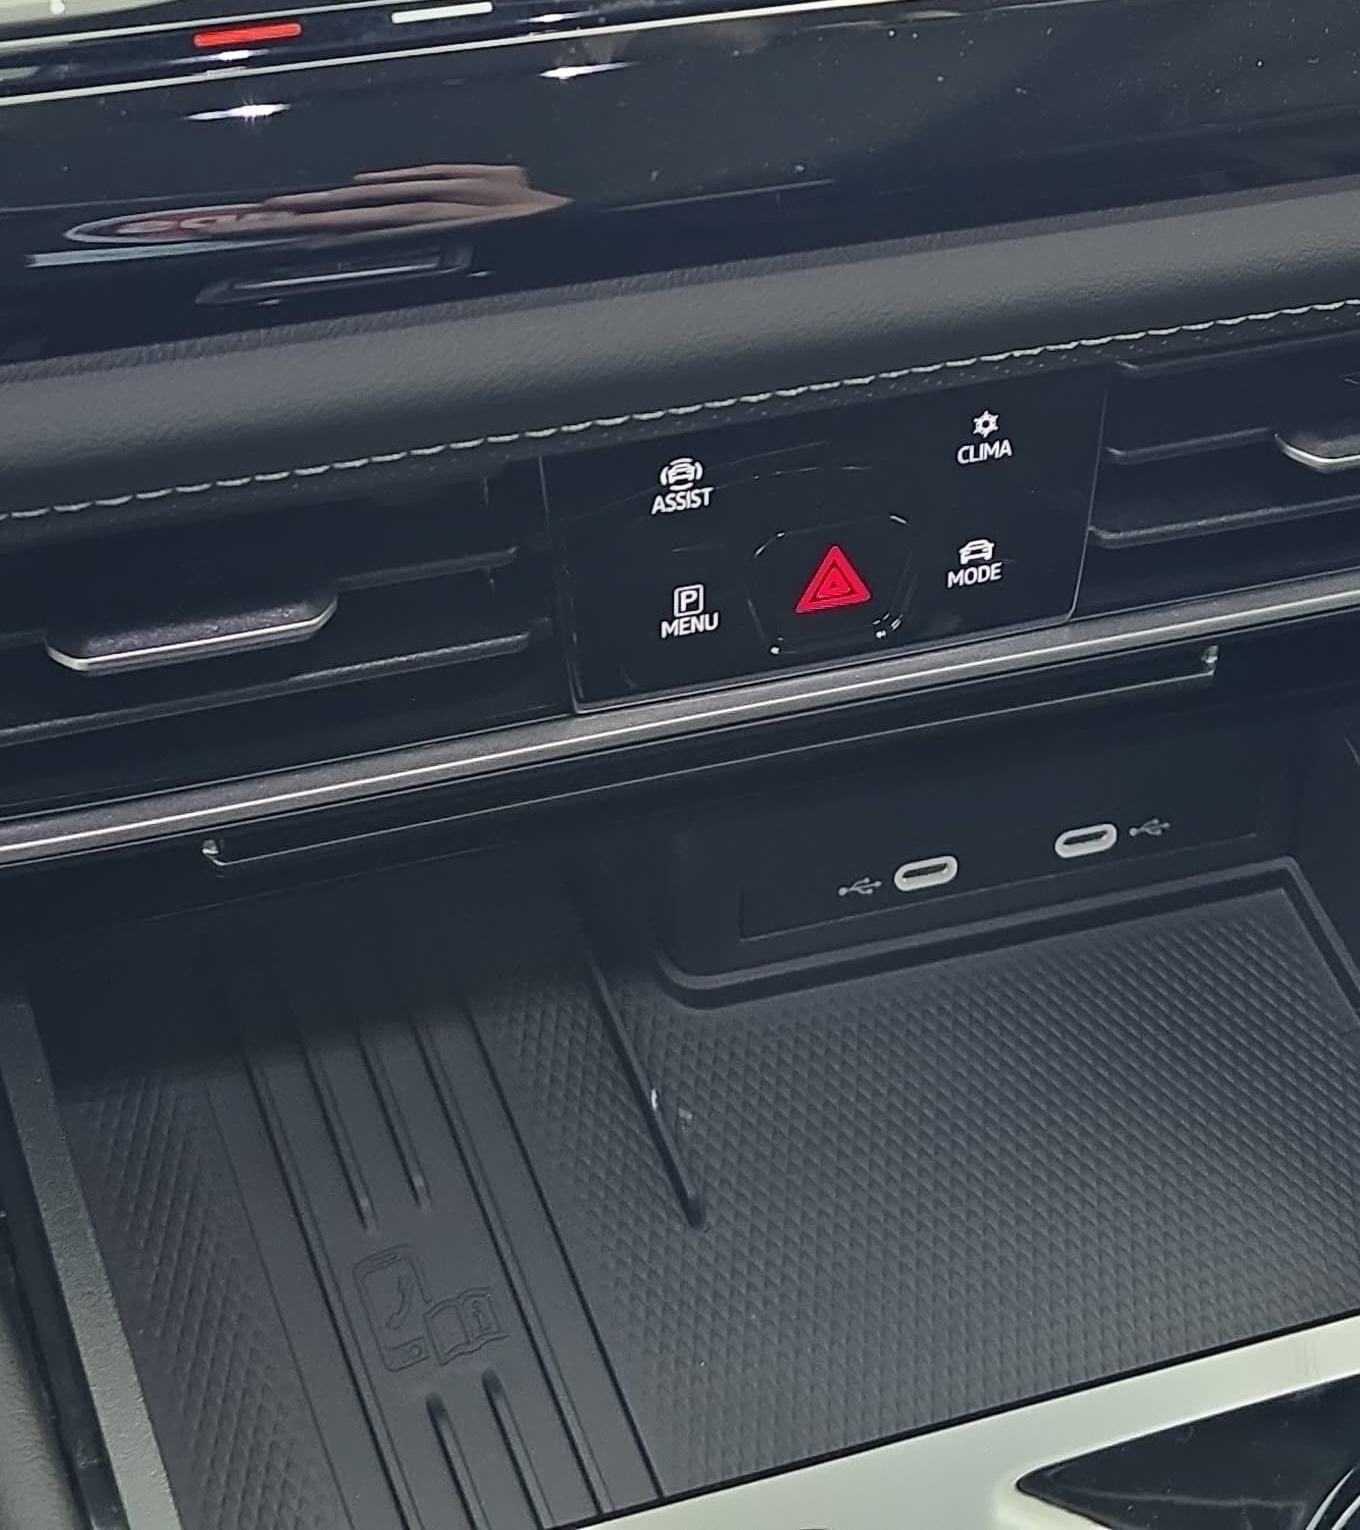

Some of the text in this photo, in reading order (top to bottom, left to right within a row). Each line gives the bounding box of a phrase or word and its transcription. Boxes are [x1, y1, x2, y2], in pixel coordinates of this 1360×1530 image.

[956, 440, 1013, 465] CLIMA
[651, 488, 713, 514] ASSIST
[947, 562, 1003, 588] MODE
[661, 613, 720, 638] MENU
